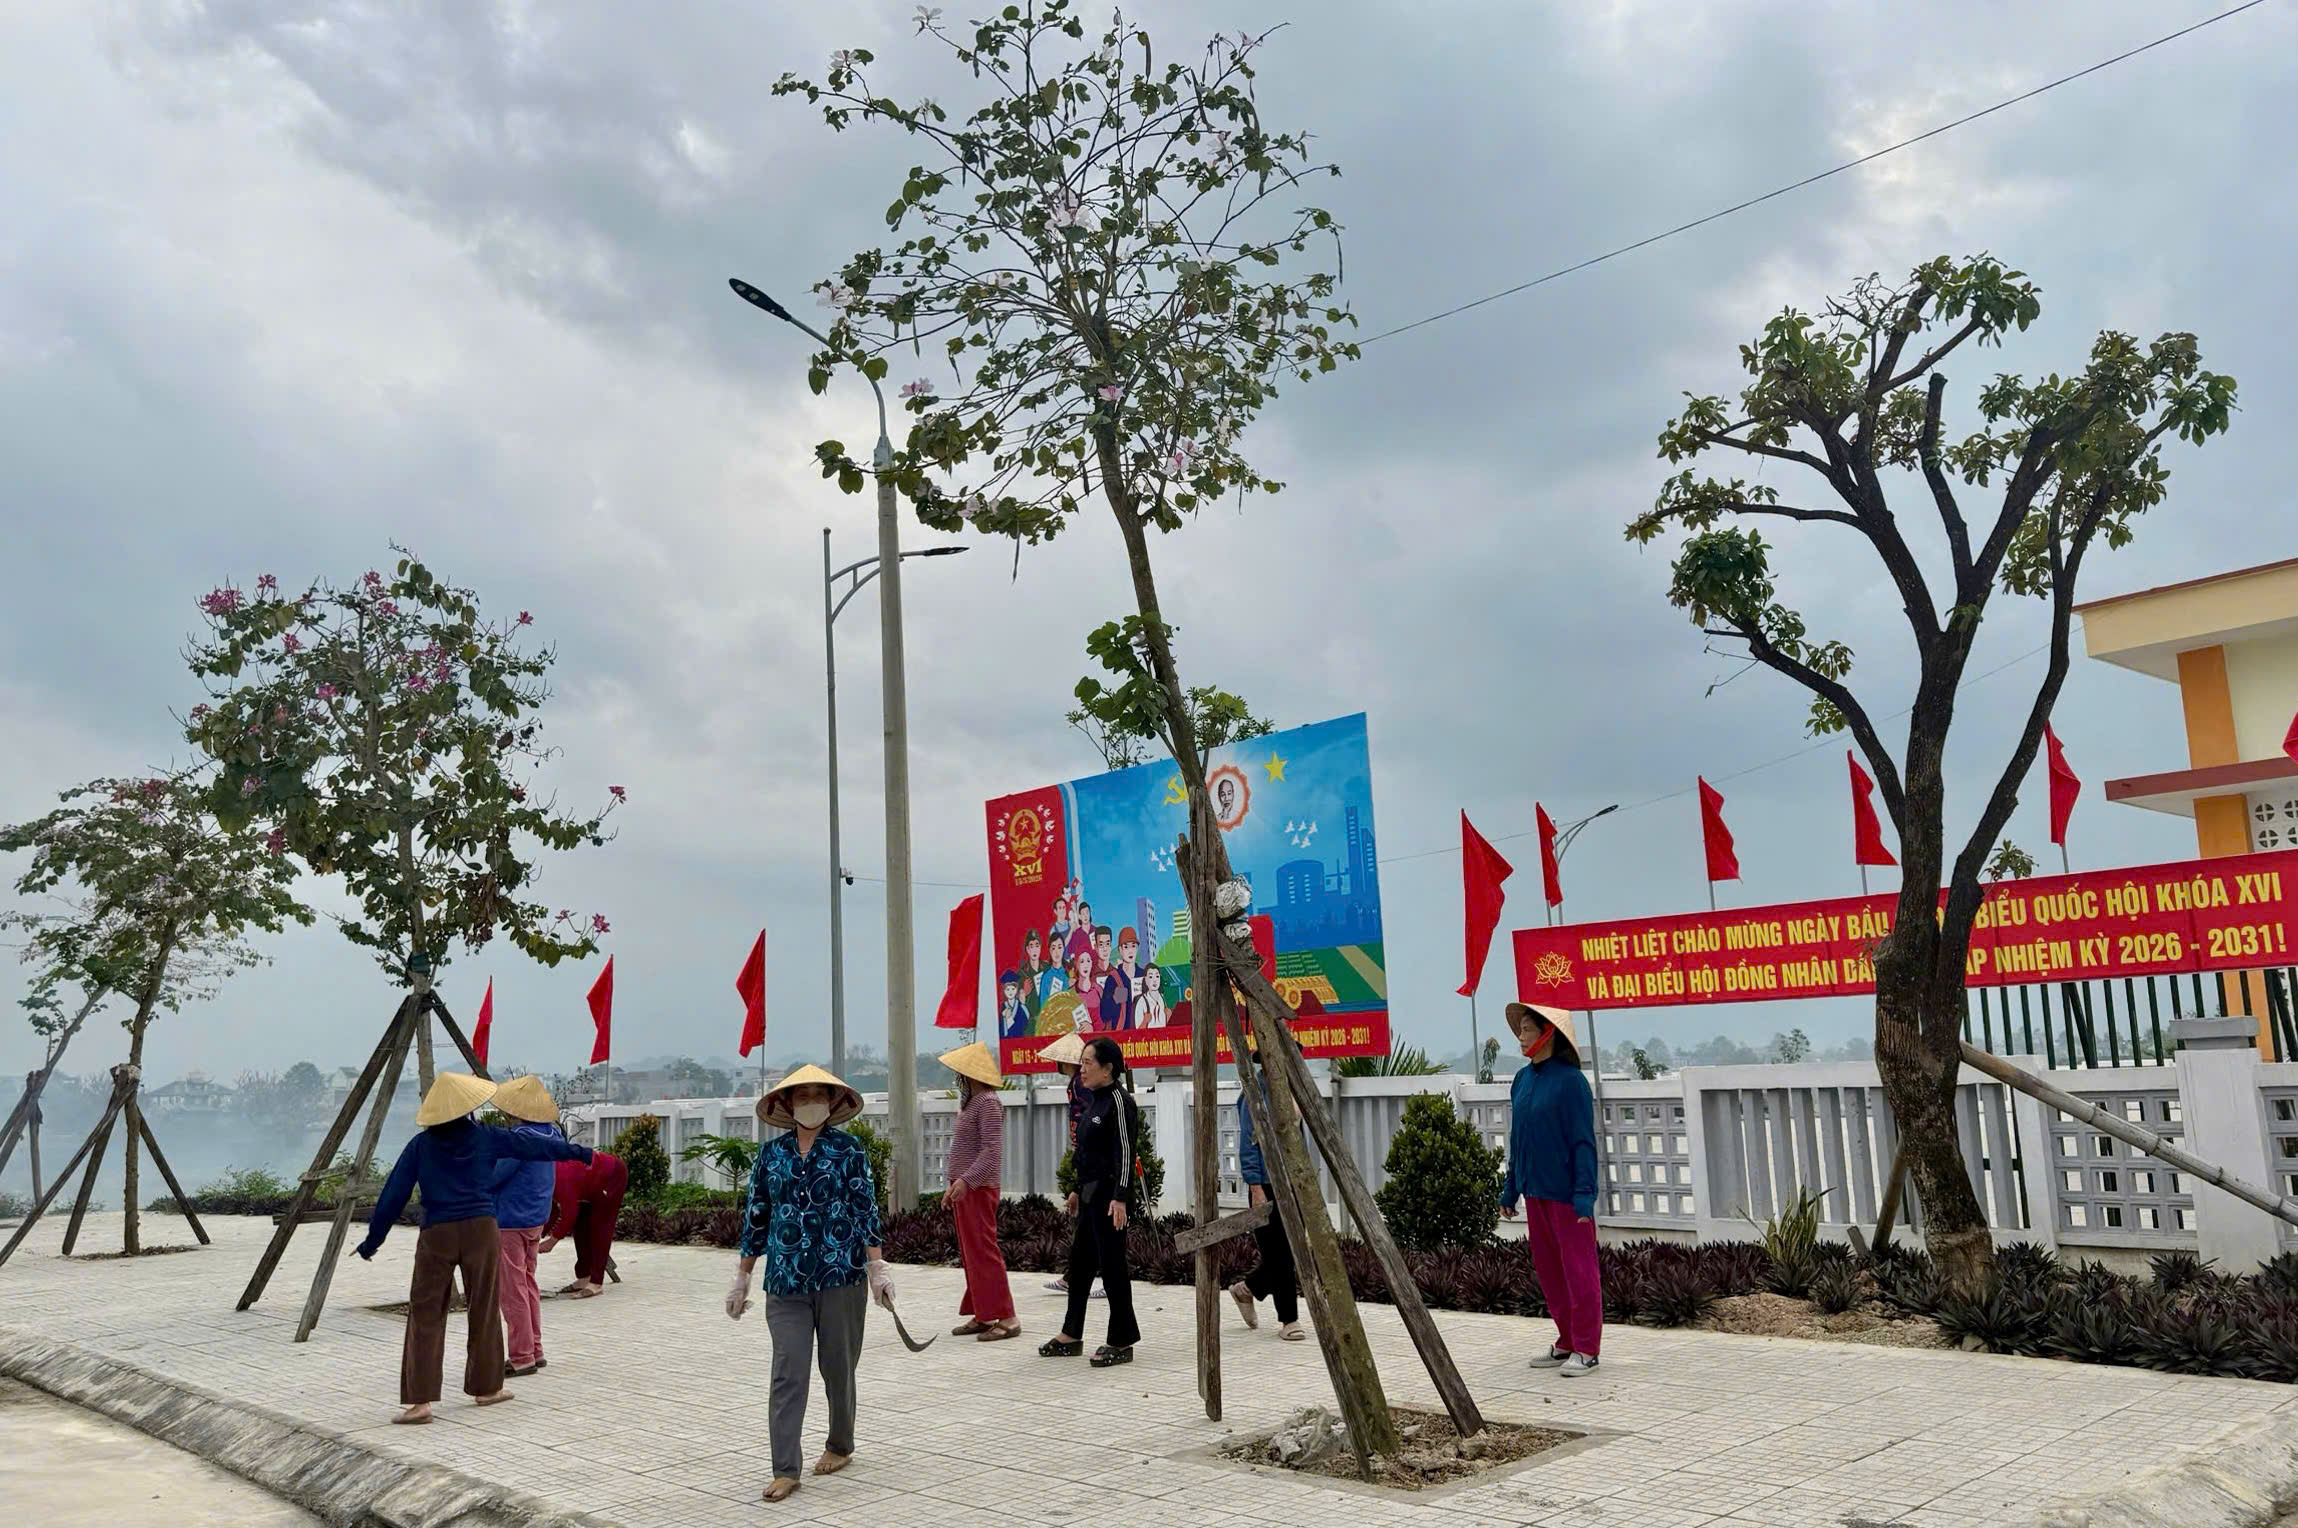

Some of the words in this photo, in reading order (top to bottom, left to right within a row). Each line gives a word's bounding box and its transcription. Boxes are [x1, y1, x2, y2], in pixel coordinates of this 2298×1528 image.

[1012, 857, 1043, 877] XVI
[1581, 931, 1630, 964] NHIỆT
[1633, 928, 1669, 961] LIỆT
[1673, 923, 1721, 955] CHÀO
[1725, 920, 1784, 951] MỪNG
[1788, 912, 1840, 945] NGÀY
[1846, 904, 1890, 940] BẦU
[1975, 887, 2027, 930] BIỂU
[2033, 881, 2099, 923] QUỐC
[2106, 880, 2149, 922] HỘI
[2156, 873, 2230, 912] KHÓA
[2237, 871, 2282, 905] XVI
[1586, 971, 1610, 1001] VÀ
[1612, 974, 1641, 1003] ĐẠI
[1646, 962, 1684, 996] BIỂU
[1689, 963, 1721, 999] HỘI
[1724, 957, 1777, 992] ĐỒNG
[1781, 955, 1838, 988] NHÂN
[1994, 937, 2073, 977] NHIỆM
[2079, 932, 2110, 968] KỲ
[2118, 931, 2182, 964] 2026
[2207, 923, 2287, 958] 2031!
[1330, 1027, 1347, 1047] 2026
